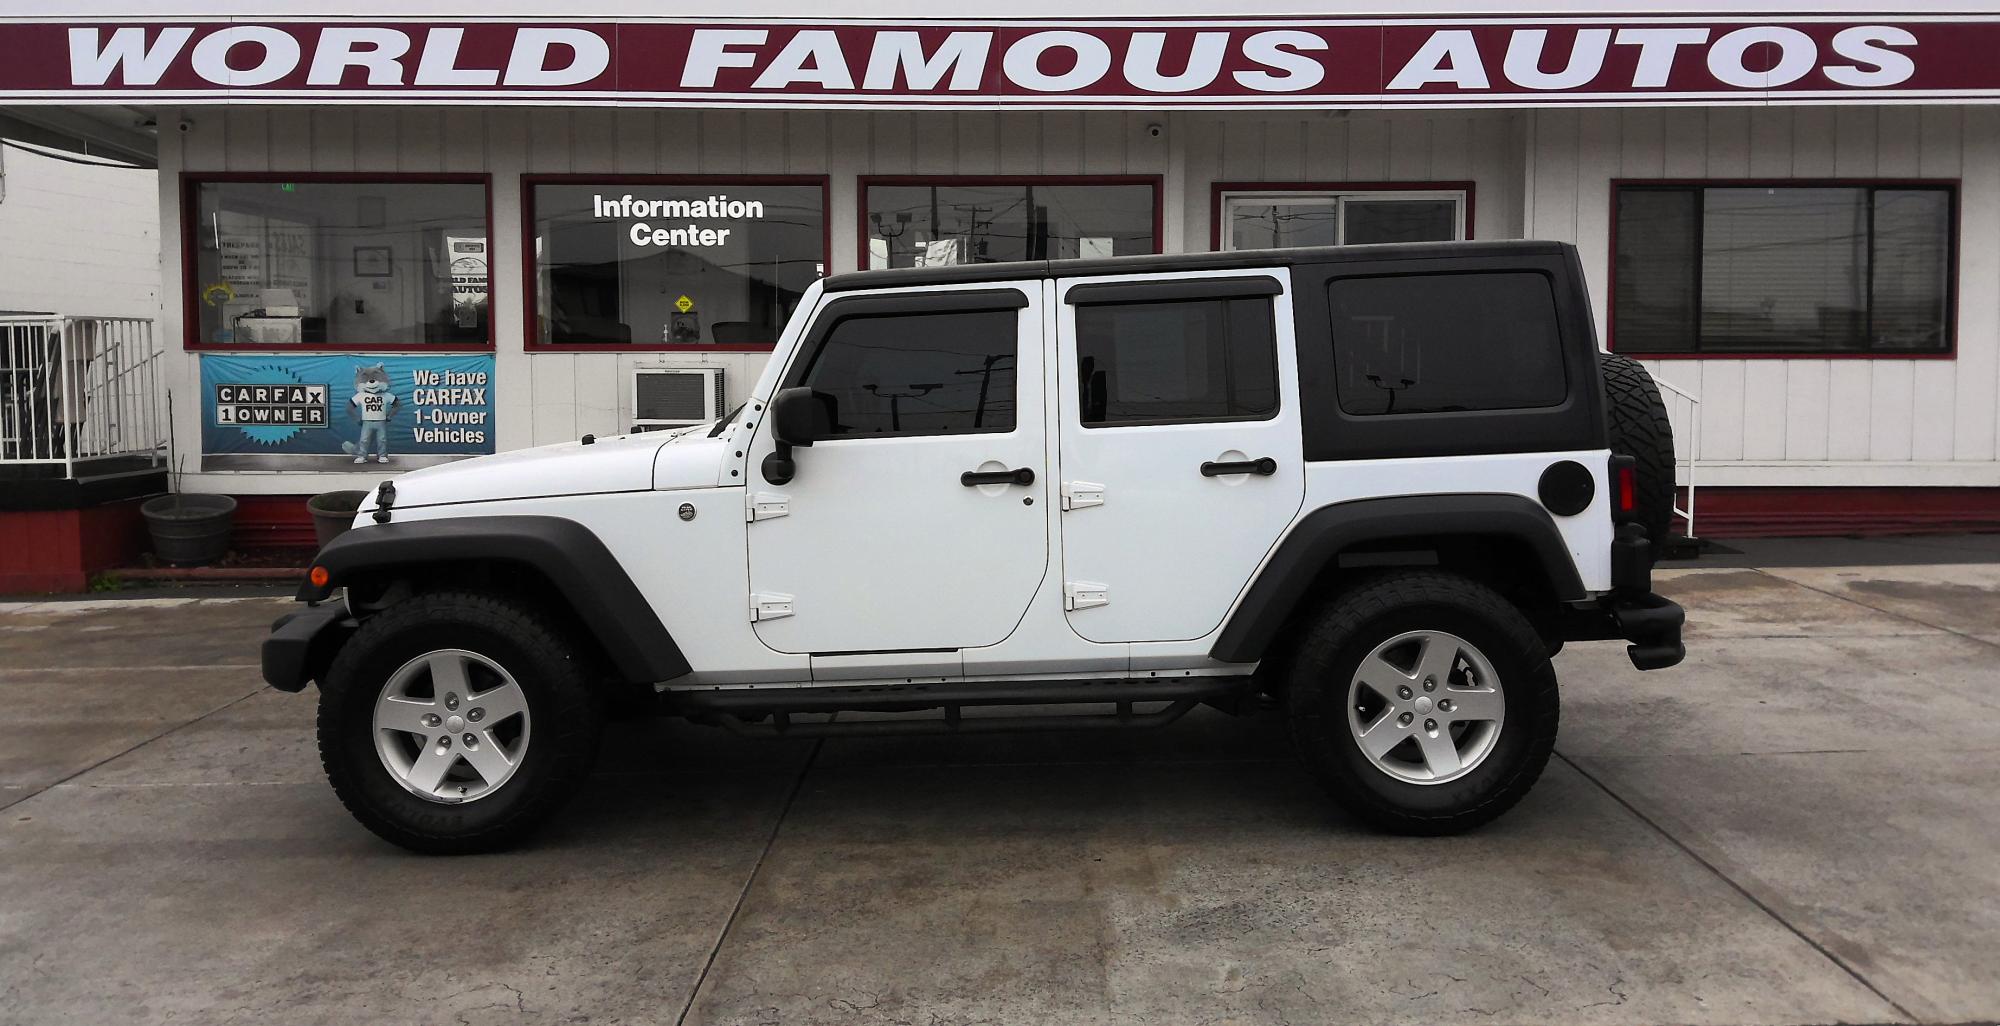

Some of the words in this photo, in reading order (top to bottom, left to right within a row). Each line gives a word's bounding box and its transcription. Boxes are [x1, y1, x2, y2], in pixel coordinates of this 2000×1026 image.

[69, 27, 610, 87] WORLD
[680, 29, 1328, 93] FAMOUS
[1386, 26, 1917, 91] AUTOS
[593, 194, 764, 219] Information
[629, 222, 731, 247] Center
[412, 370, 440, 386] We
[445, 370, 487, 386] have
[220, 388, 322, 404] CARFAX
[364, 396, 383, 404] CAR
[413, 388, 486, 406] CARFAX
[366, 404, 383, 412] FOX
[414, 408, 487, 425] 1-Owner
[413, 427, 485, 443] Vehicles
